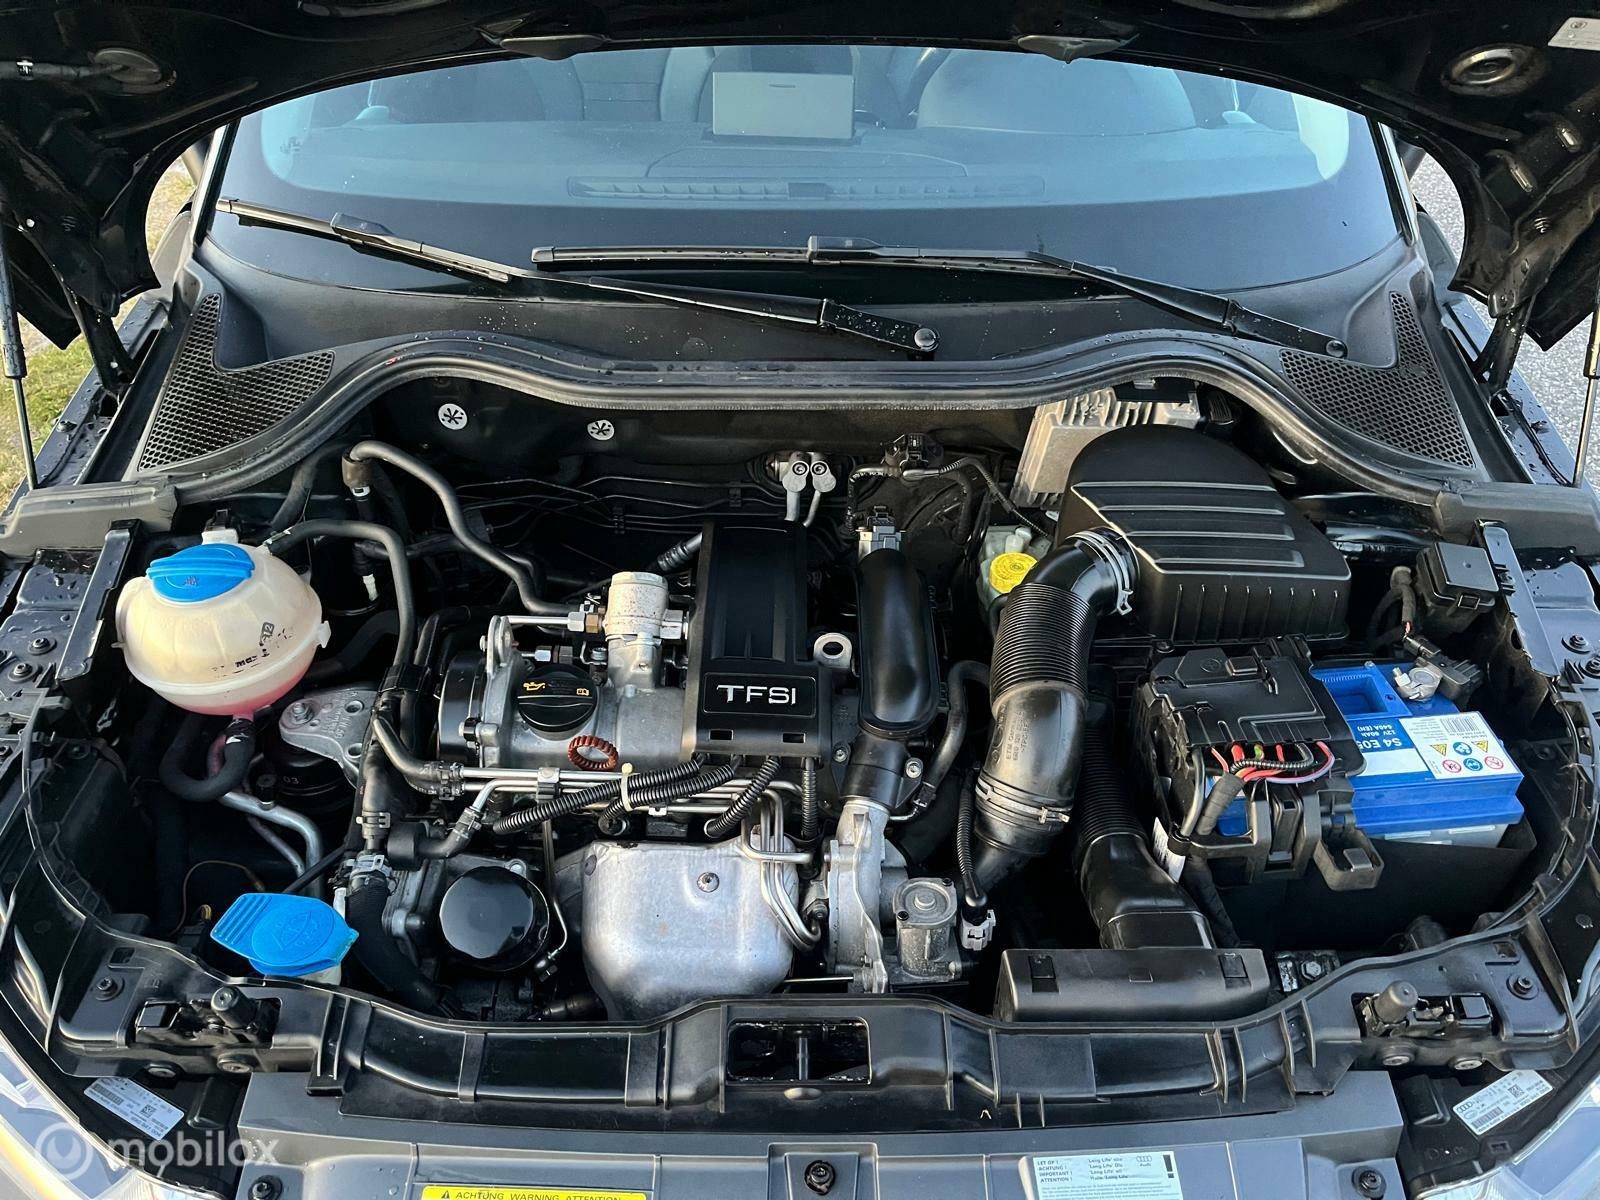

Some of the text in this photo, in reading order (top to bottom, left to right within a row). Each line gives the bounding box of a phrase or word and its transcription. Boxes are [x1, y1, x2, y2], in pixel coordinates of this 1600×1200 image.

[716, 684, 796, 705] TFSI
[1357, 737, 1402, 749] S4 E05
[456, 1191, 504, 1200] ACHTUNG
